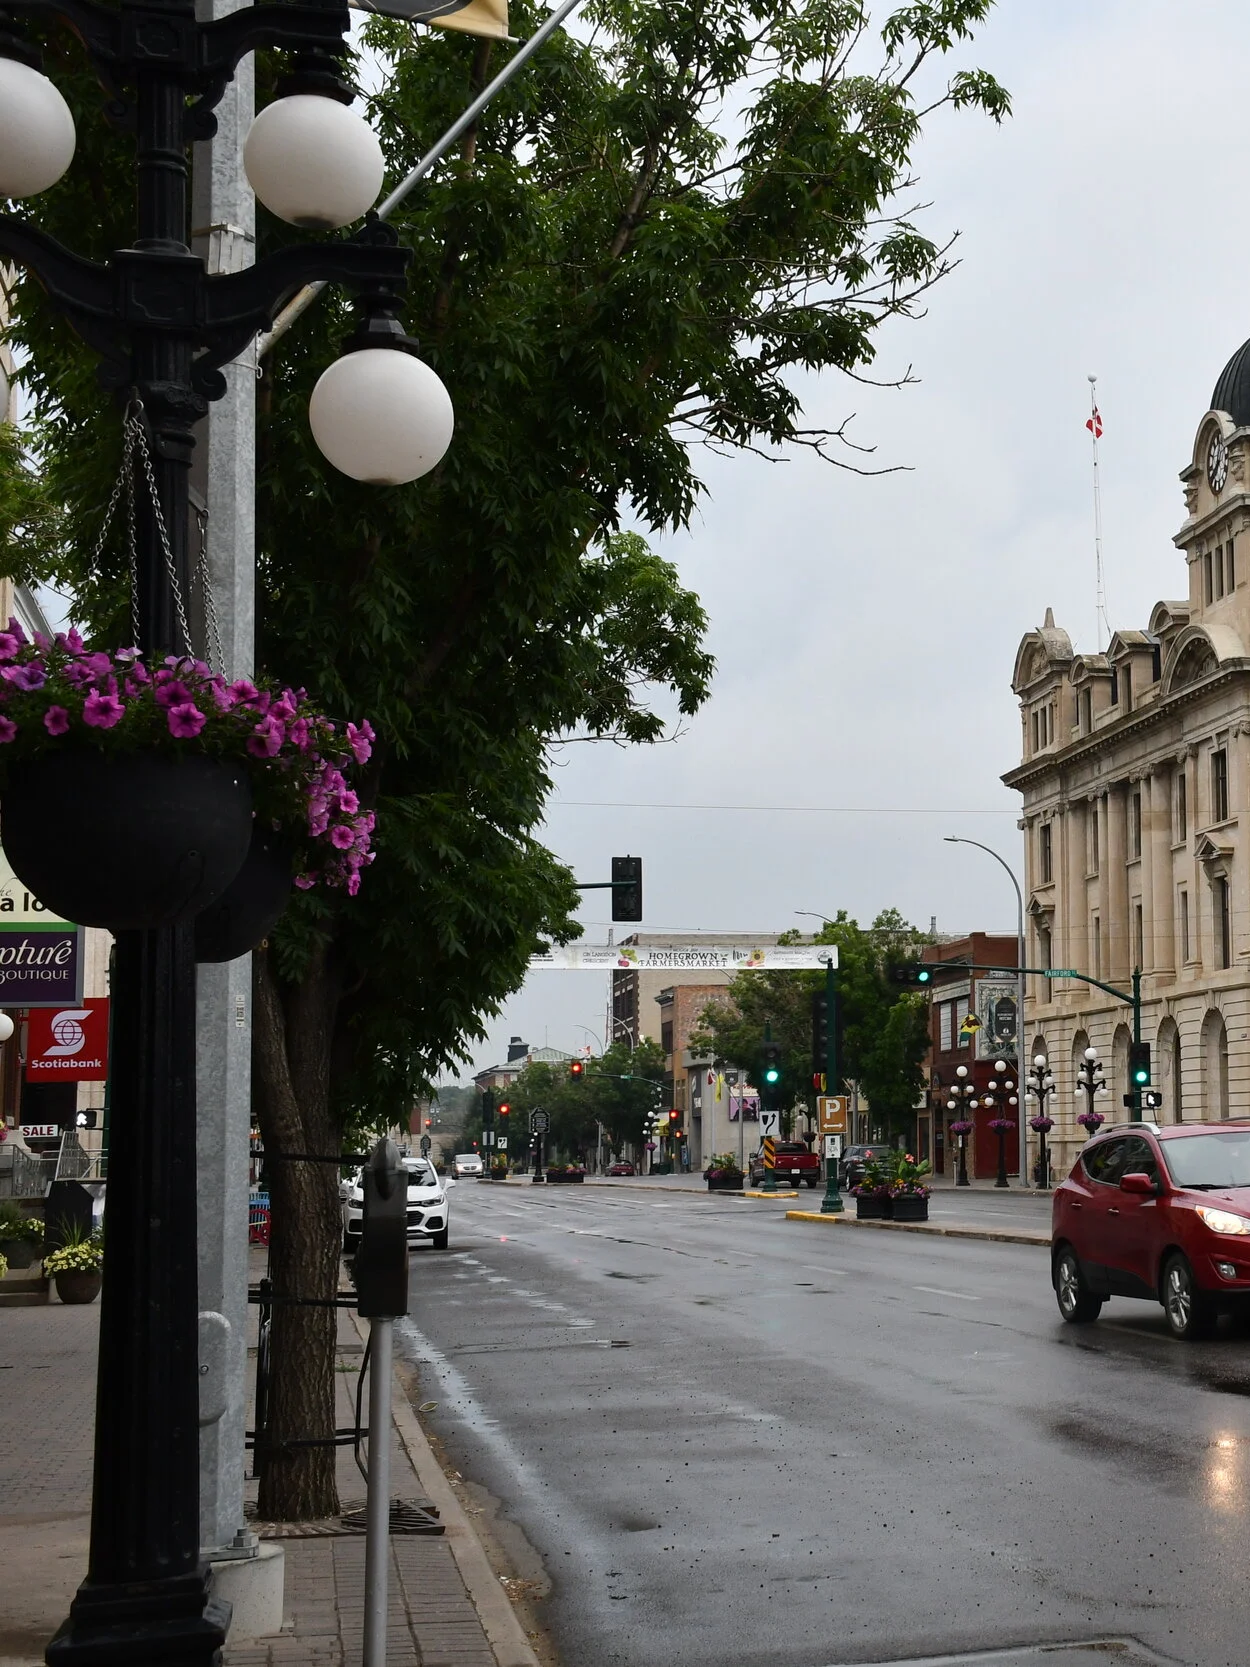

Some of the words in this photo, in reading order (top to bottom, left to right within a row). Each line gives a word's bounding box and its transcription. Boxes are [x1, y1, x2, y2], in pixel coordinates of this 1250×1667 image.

[649, 952, 718, 961] HOMEGROWN
[31, 1058, 102, 1069] Scotiabank
[825, 1099, 840, 1120] P
[22, 1126, 54, 1137] SALE
